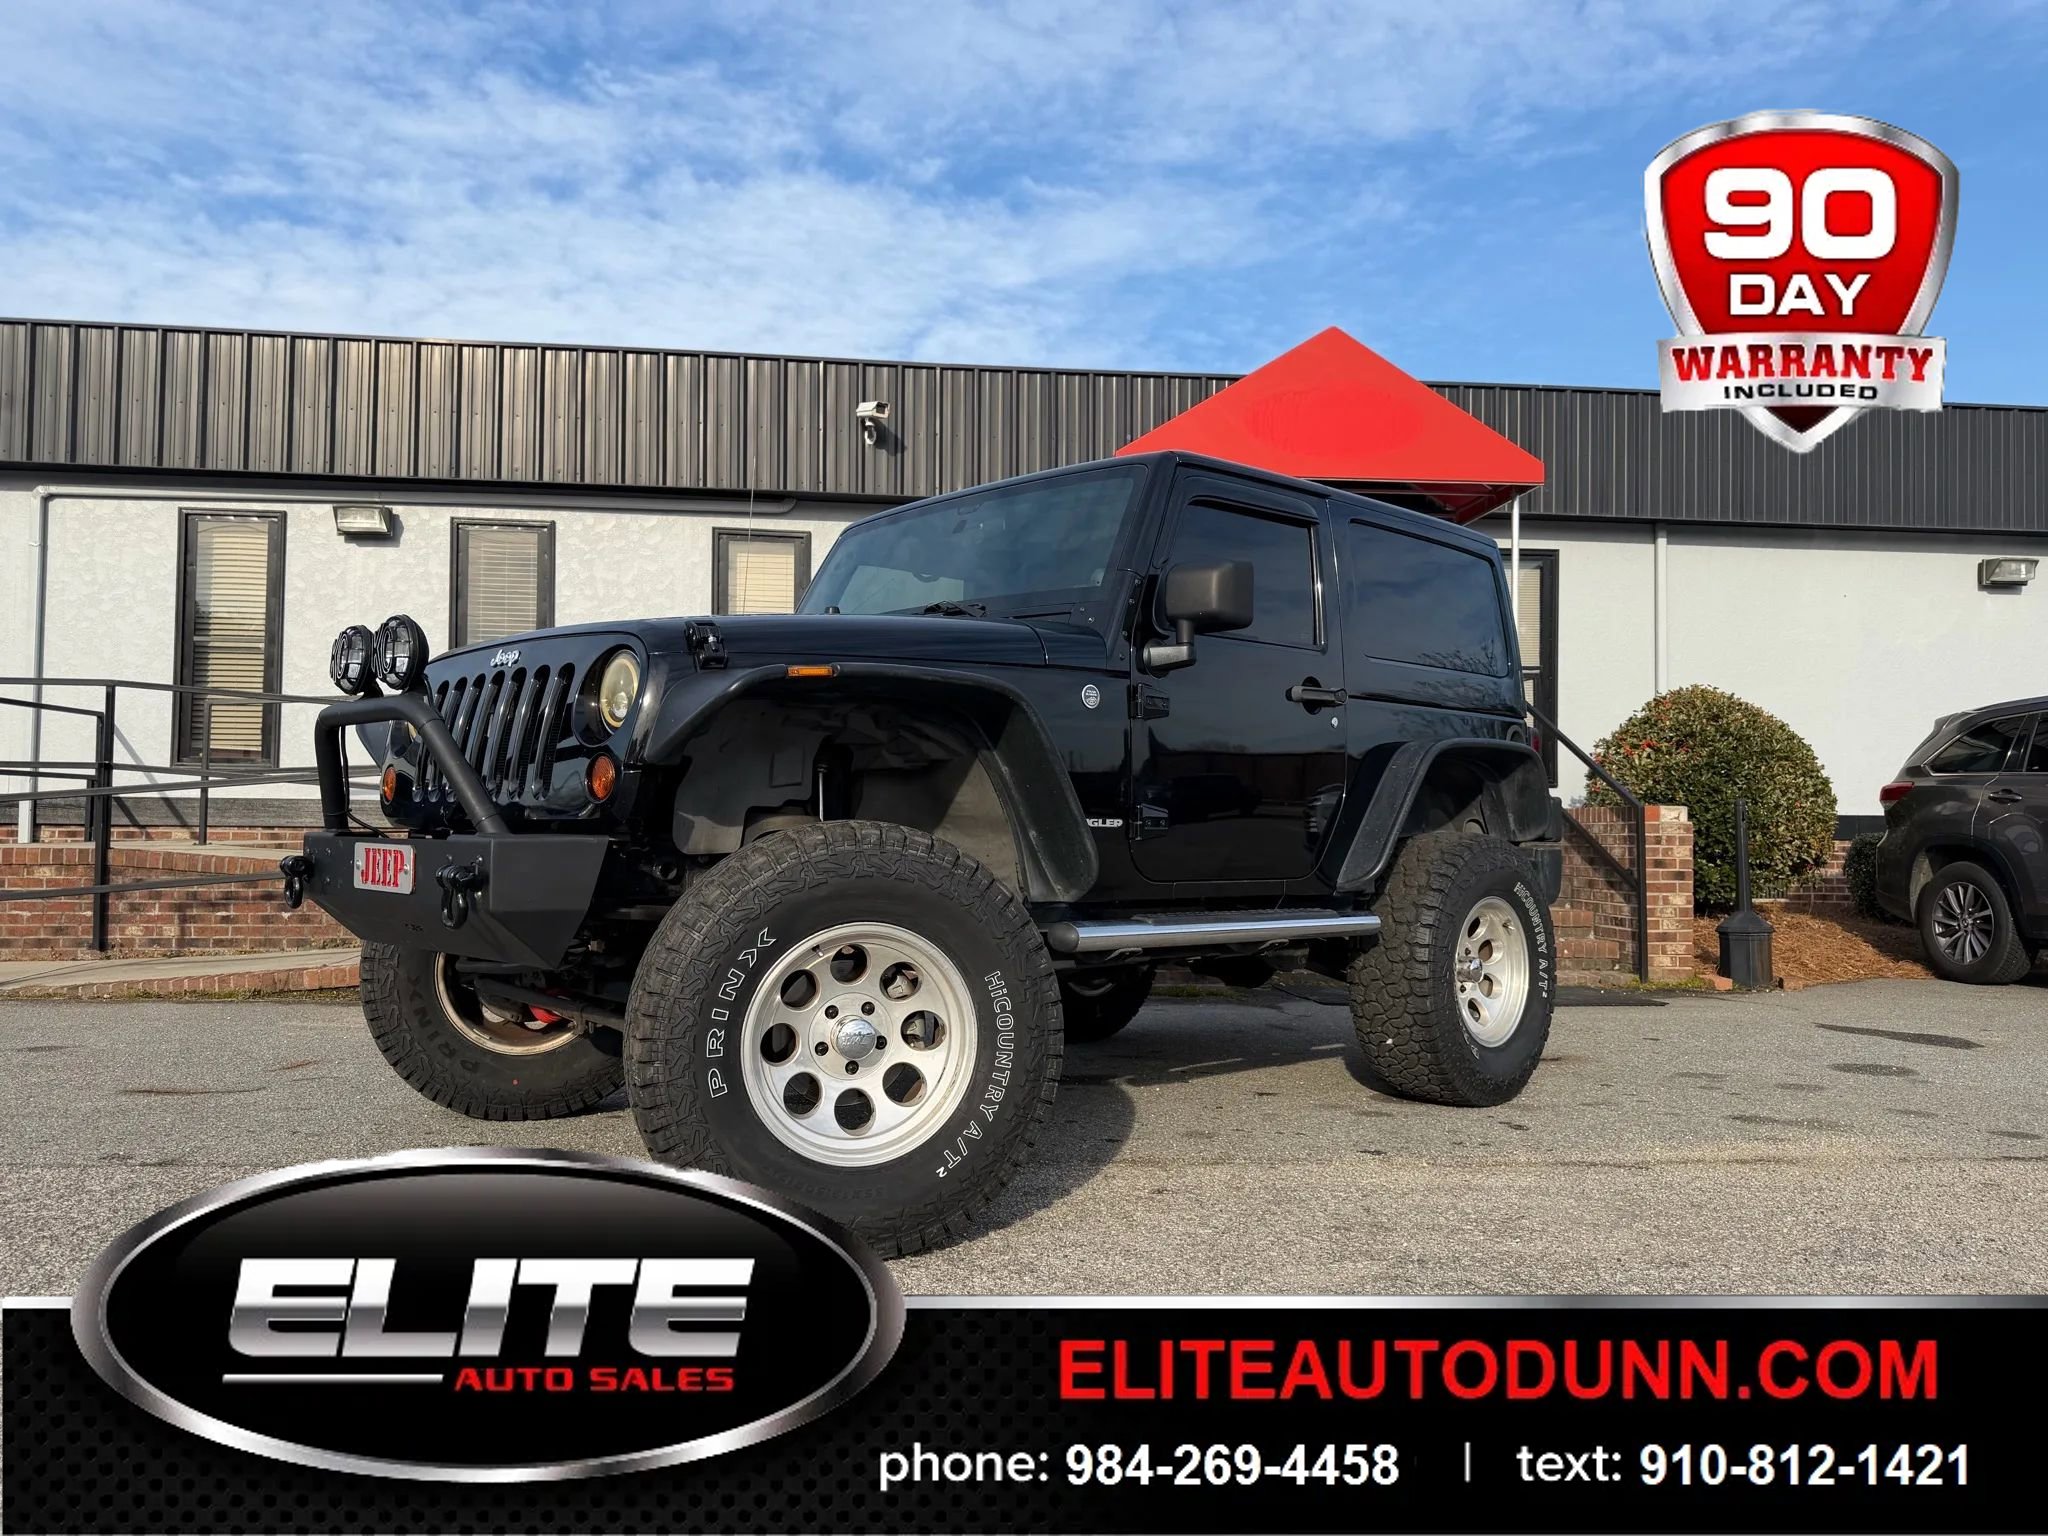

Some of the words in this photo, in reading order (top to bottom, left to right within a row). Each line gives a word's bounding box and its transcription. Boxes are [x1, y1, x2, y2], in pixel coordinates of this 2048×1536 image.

[490, 649, 520, 667] Jeep
[361, 847, 405, 887] JEEP
[707, 927, 777, 1098] PRINX
